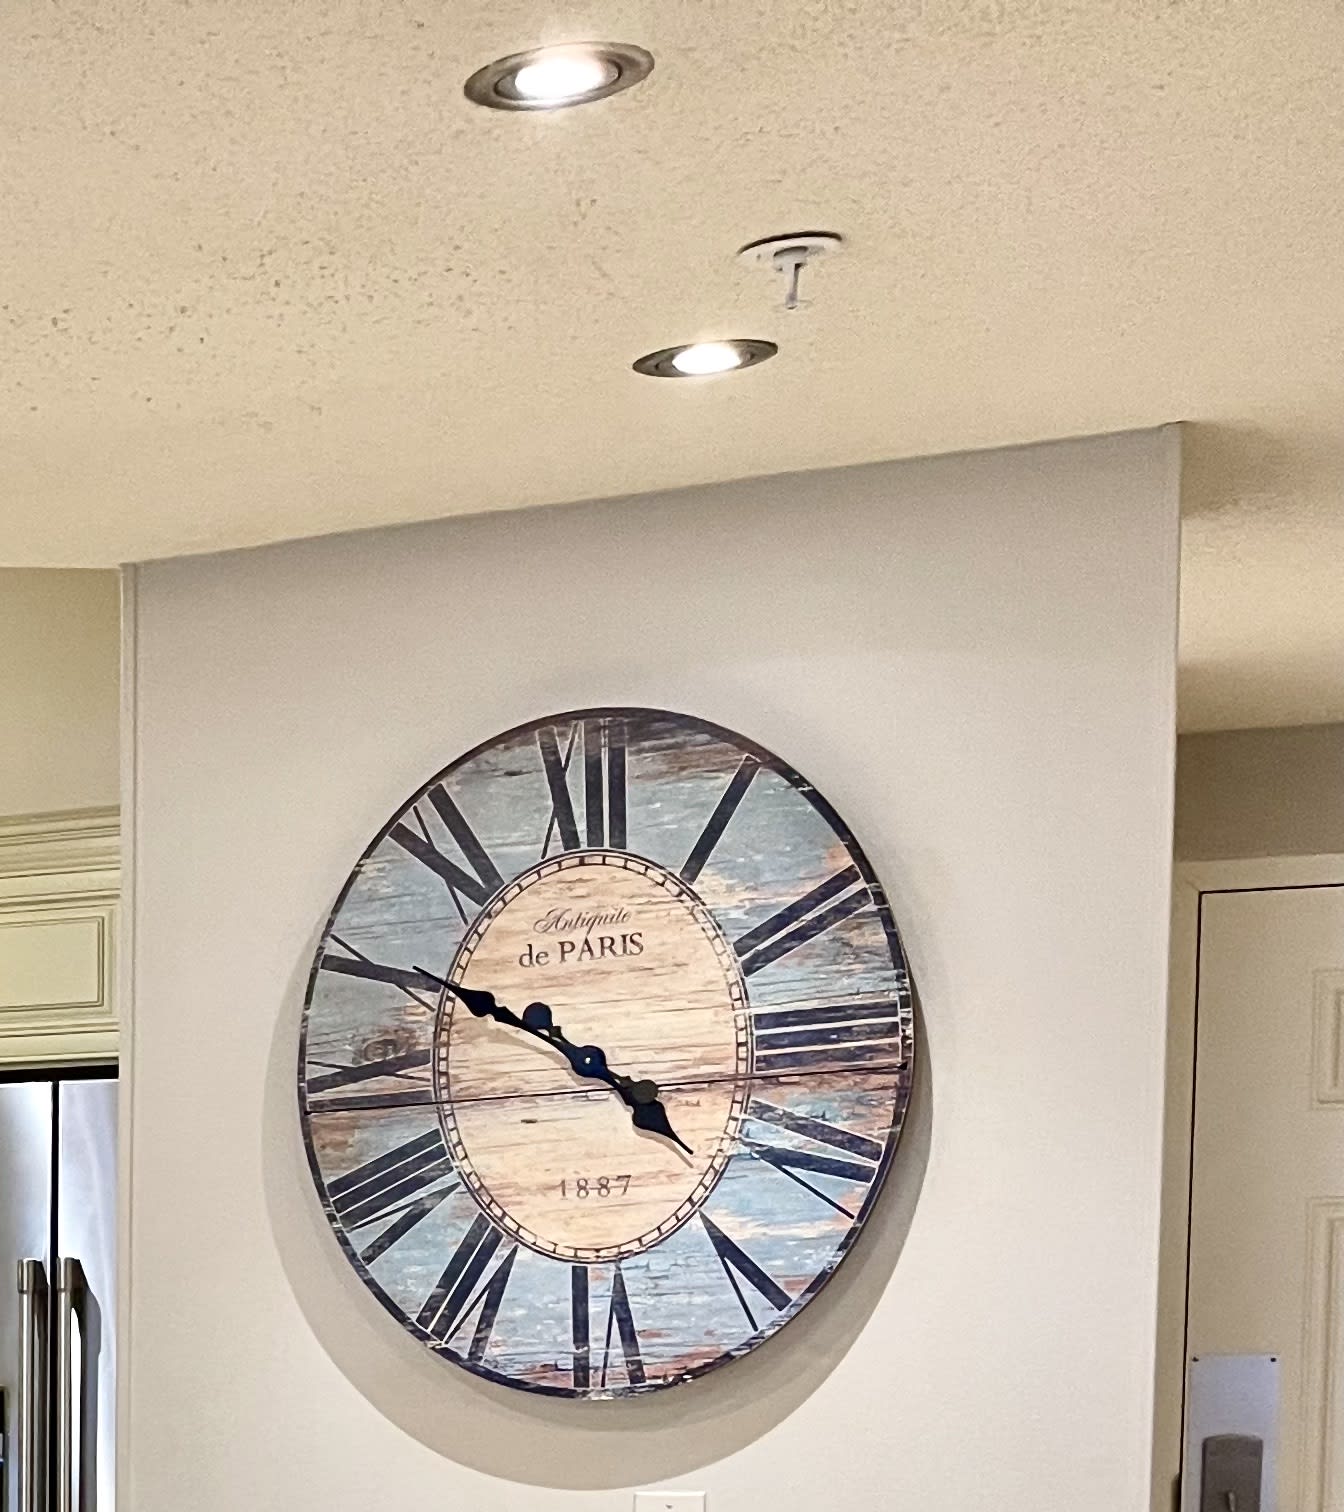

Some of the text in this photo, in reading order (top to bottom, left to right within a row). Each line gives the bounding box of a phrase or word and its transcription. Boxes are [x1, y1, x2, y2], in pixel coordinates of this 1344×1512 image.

[536, 719, 627, 859] XII
[388, 783, 505, 925] XI
[320, 934, 442, 1012] X
[518, 931, 644, 968] de PARIS
[733, 864, 874, 977] II
[306, 1049, 433, 1111] IX
[753, 998, 900, 1072] III
[327, 1128, 462, 1265] VIII
[560, 1174, 632, 1199] 1887
[740, 1098, 885, 1219] IV
[416, 1212, 519, 1363] VII
[570, 1262, 647, 1389] VI
[699, 1208, 792, 1331] V
